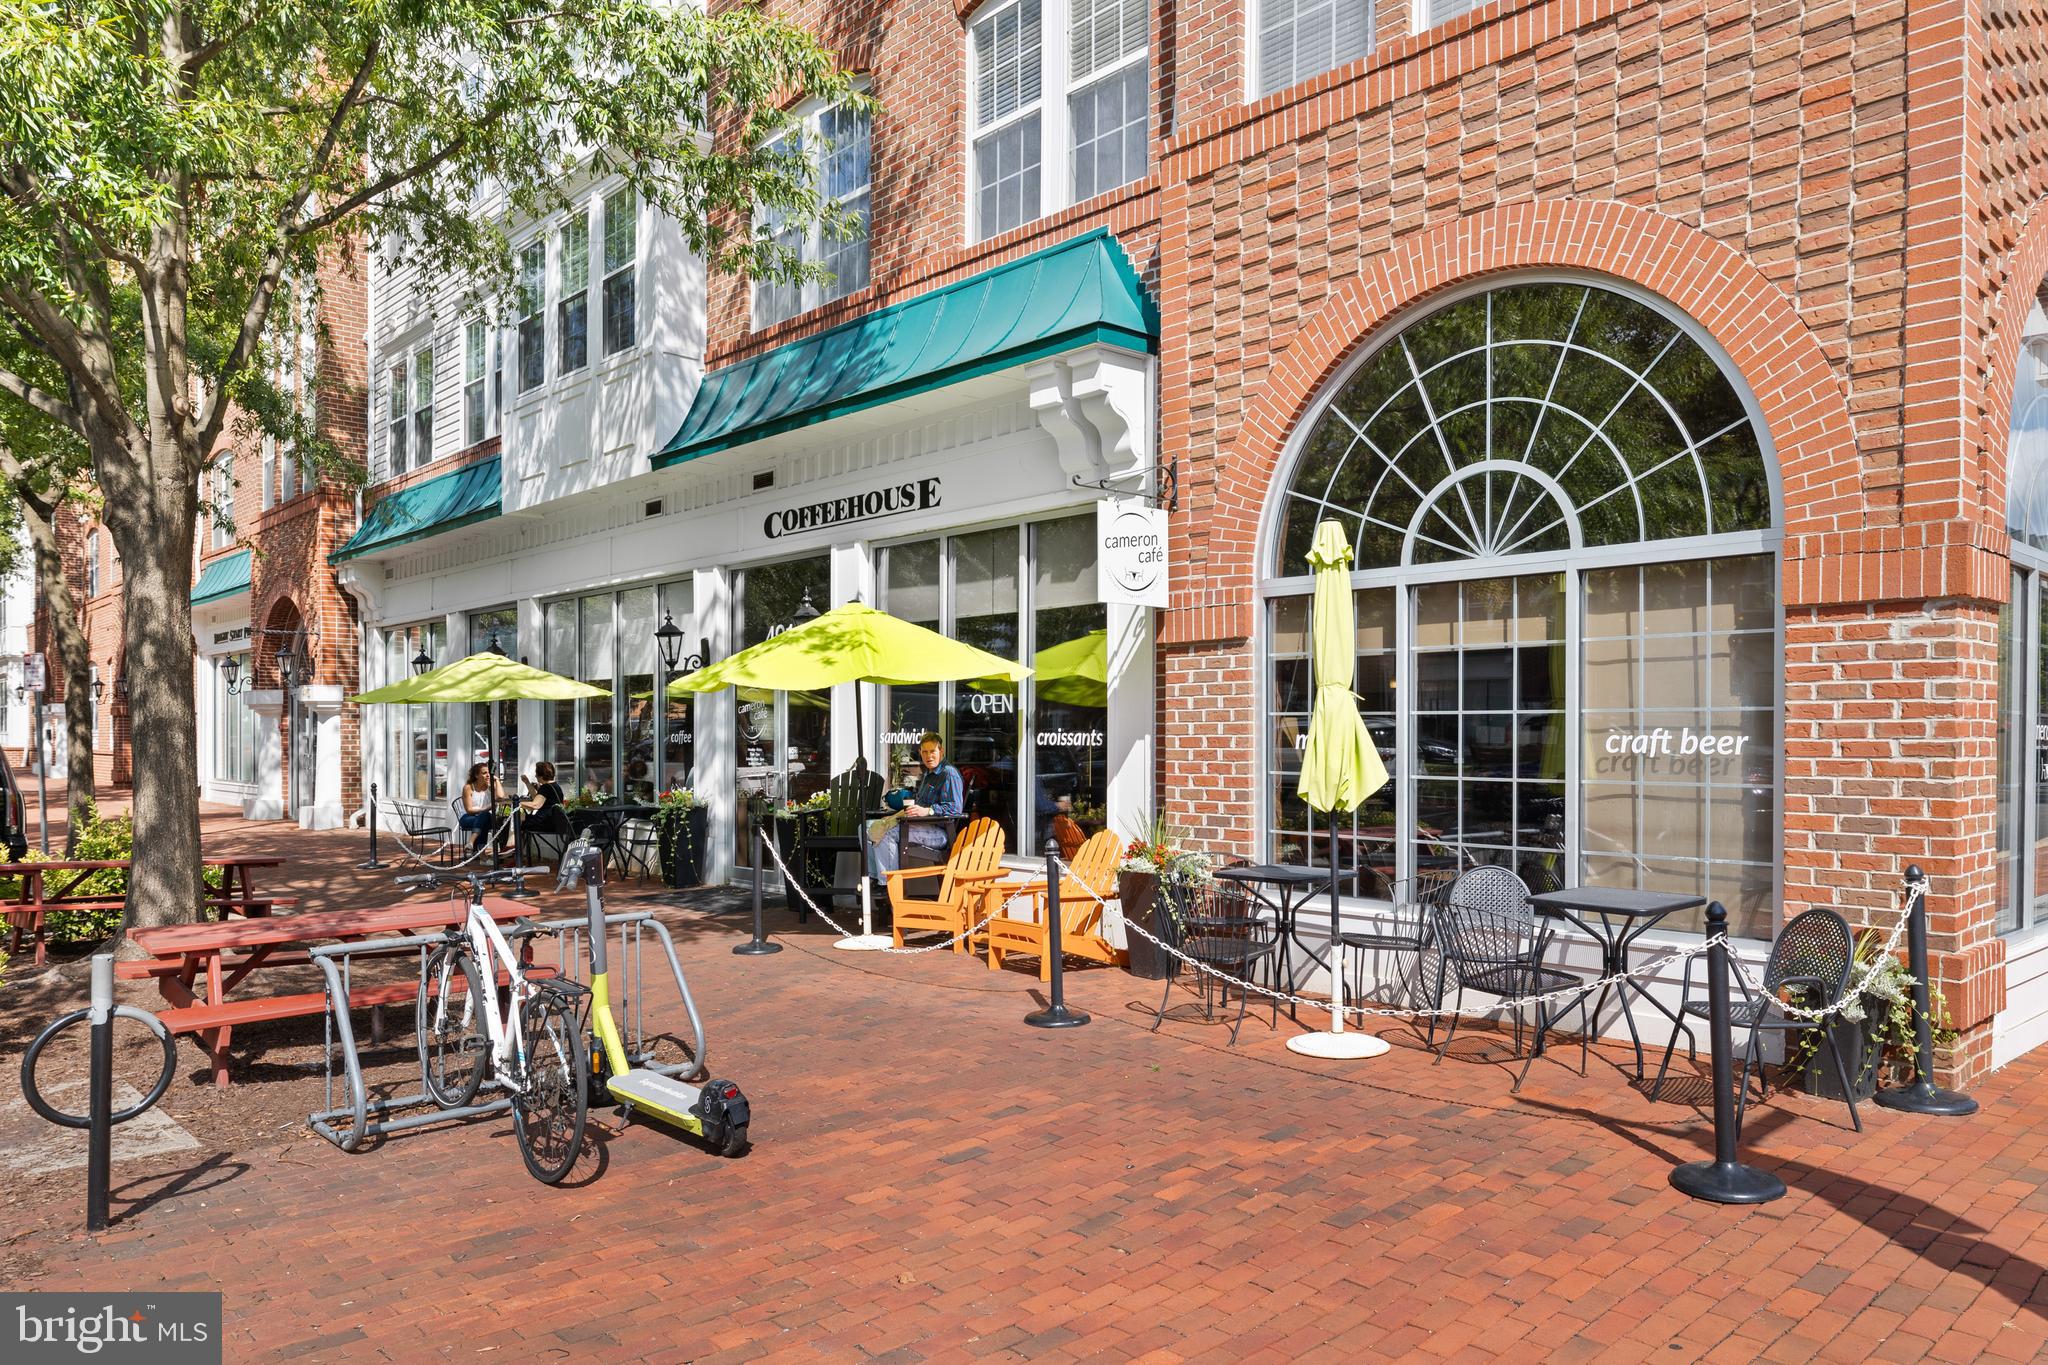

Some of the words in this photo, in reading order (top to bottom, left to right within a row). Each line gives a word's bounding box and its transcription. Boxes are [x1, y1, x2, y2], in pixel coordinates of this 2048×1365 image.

[764, 477, 942, 539] COFFEEHOUSE
[1105, 534, 1158, 549] cameron
[1138, 546, 1164, 564] café
[738, 699, 765, 714] cameron
[971, 693, 1014, 714] OPEN
[753, 707, 768, 721] café
[585, 732, 610, 744] espresso
[670, 730, 692, 745] coffee
[1037, 727, 1104, 747] croissants
[1605, 727, 1673, 758] craft
[1679, 727, 1749, 755] beer
